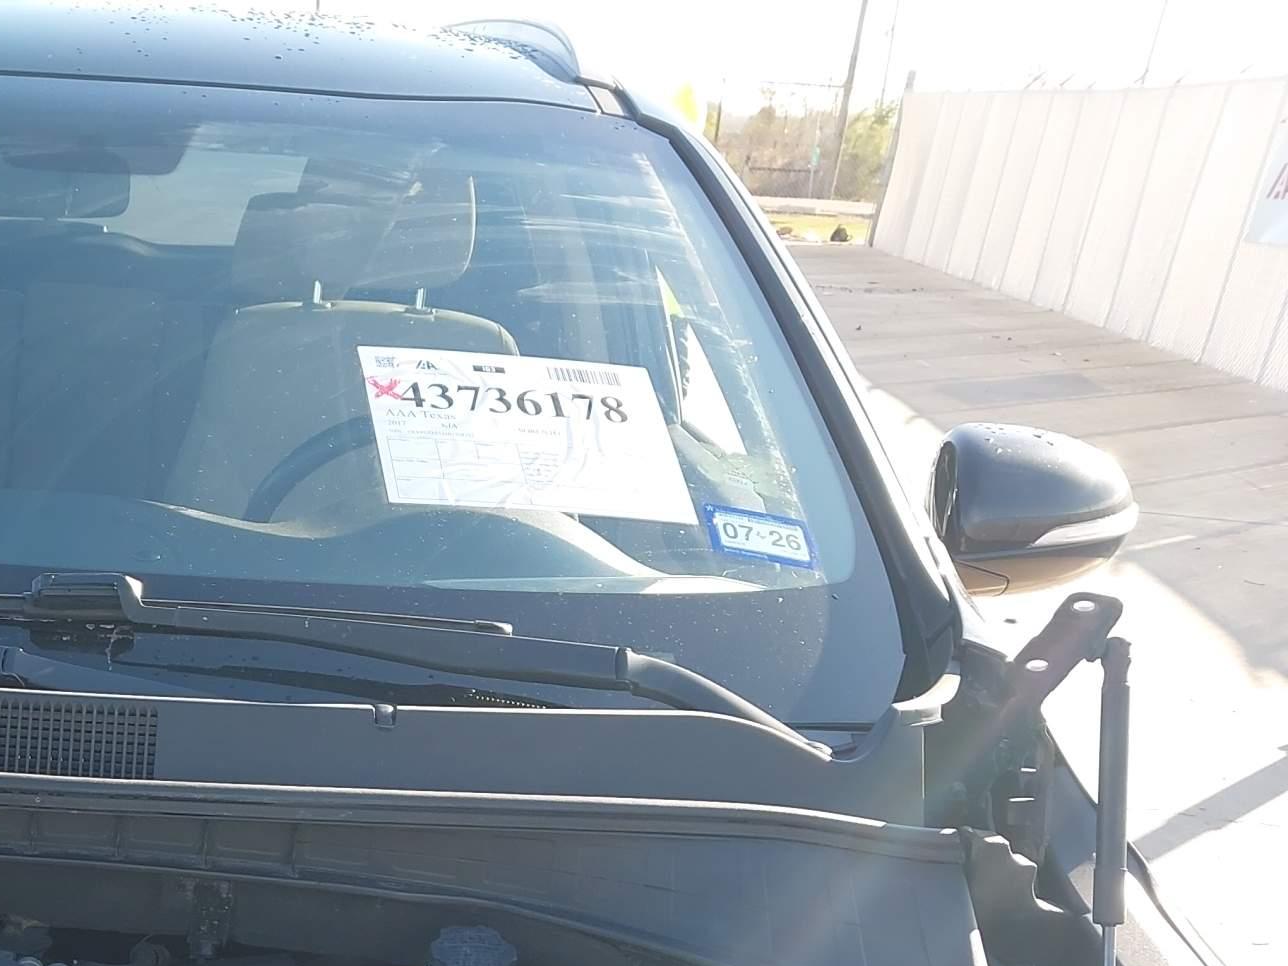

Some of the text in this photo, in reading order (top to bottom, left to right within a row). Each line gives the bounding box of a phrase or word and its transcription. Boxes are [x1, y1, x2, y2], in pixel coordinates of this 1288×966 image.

[385, 408, 457, 420] AAA Texas
[400, 382, 629, 424] 43736178
